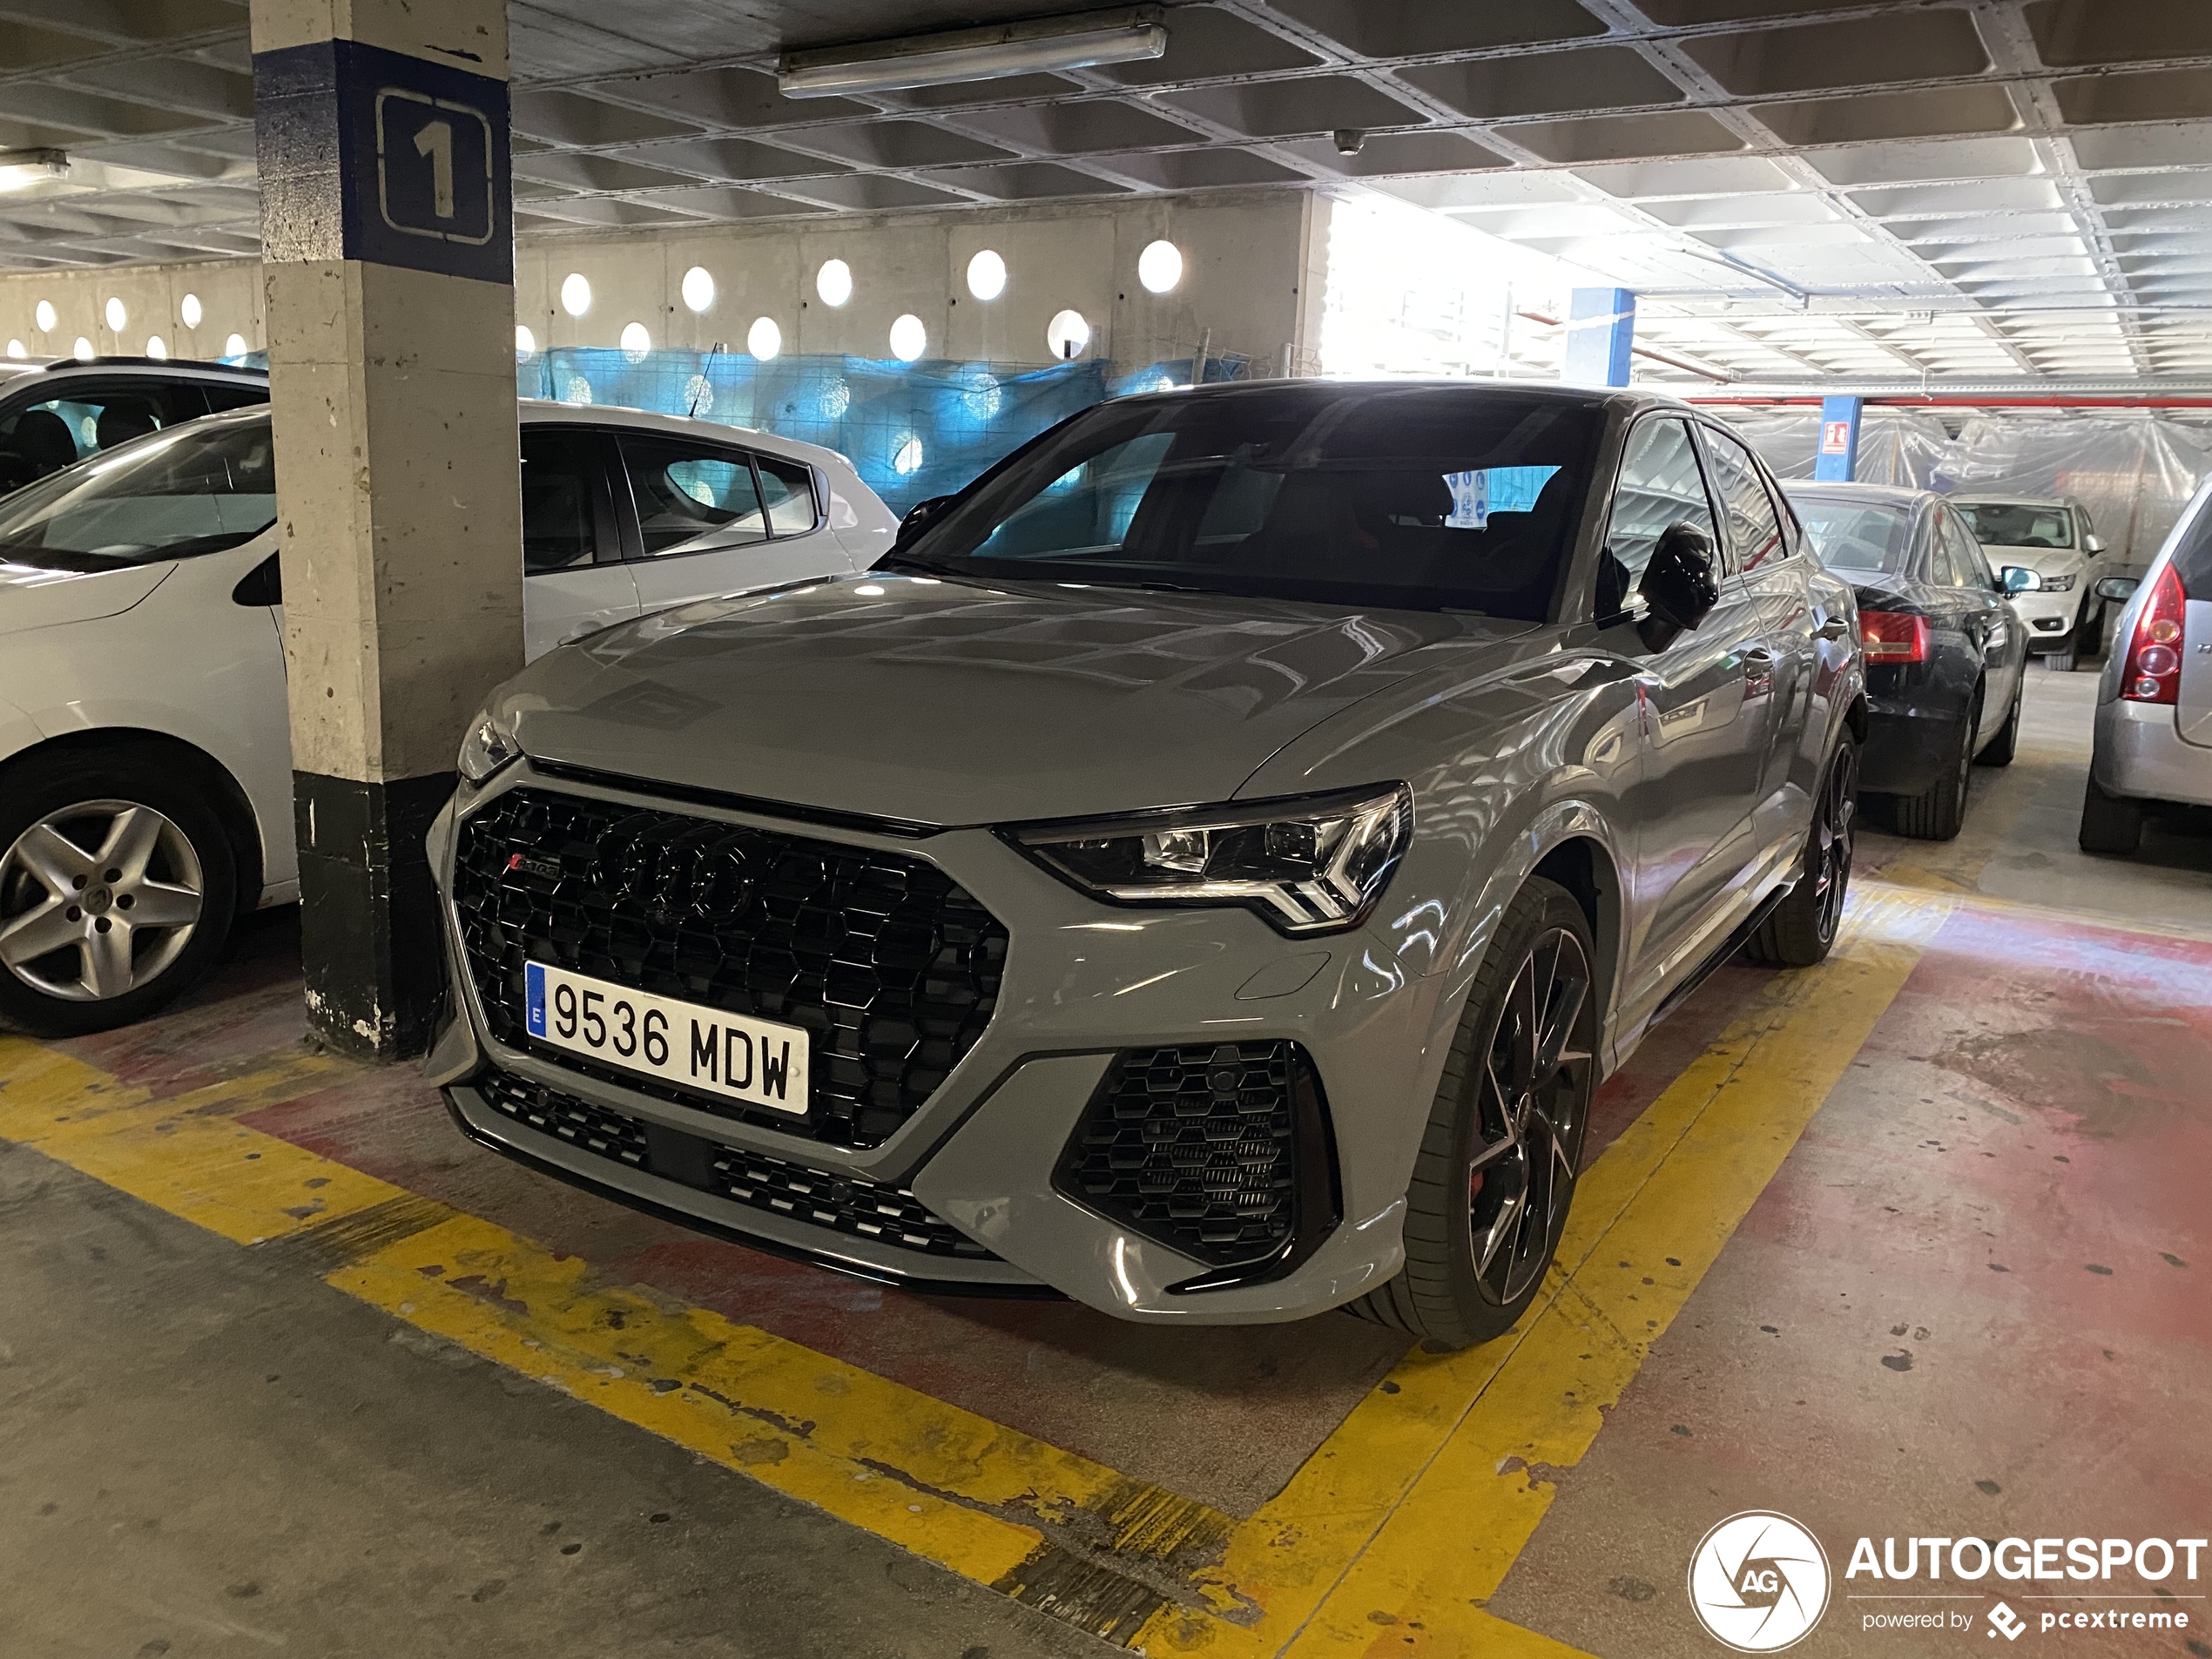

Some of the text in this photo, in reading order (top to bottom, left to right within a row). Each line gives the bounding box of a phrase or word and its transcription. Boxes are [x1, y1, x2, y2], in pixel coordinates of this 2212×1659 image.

[413, 120, 455, 219] 1
[532, 982, 791, 1101] E 9536 MDW
